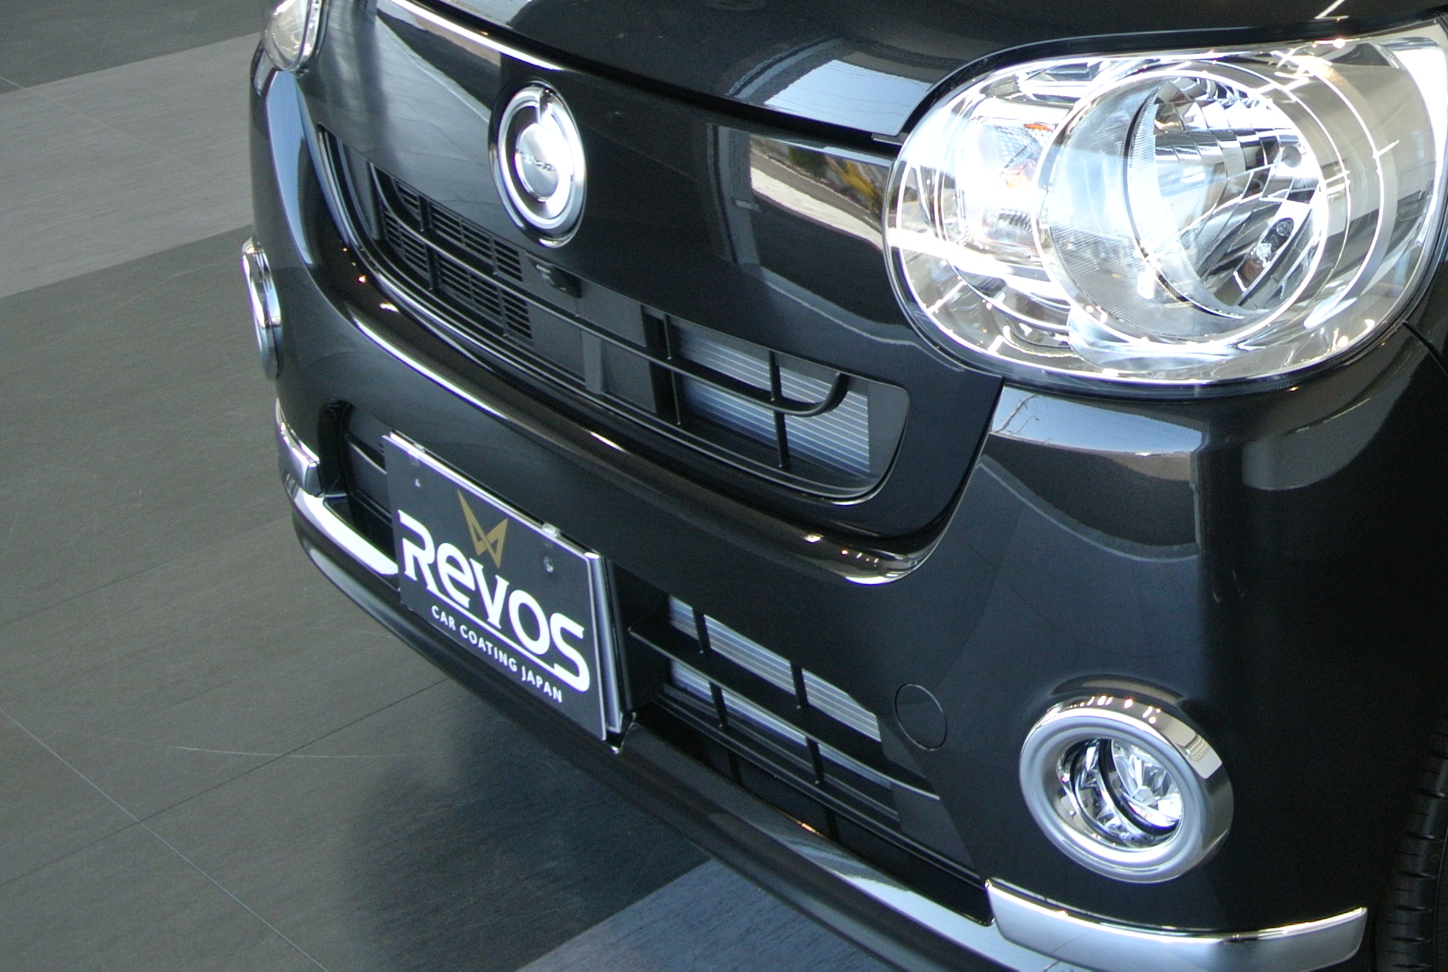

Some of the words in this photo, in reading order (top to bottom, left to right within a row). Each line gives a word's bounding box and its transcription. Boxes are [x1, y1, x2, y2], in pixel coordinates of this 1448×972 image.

[431, 605, 457, 631] CAR
[460, 624, 518, 673] COATING
[521, 665, 563, 704] JAPAN
